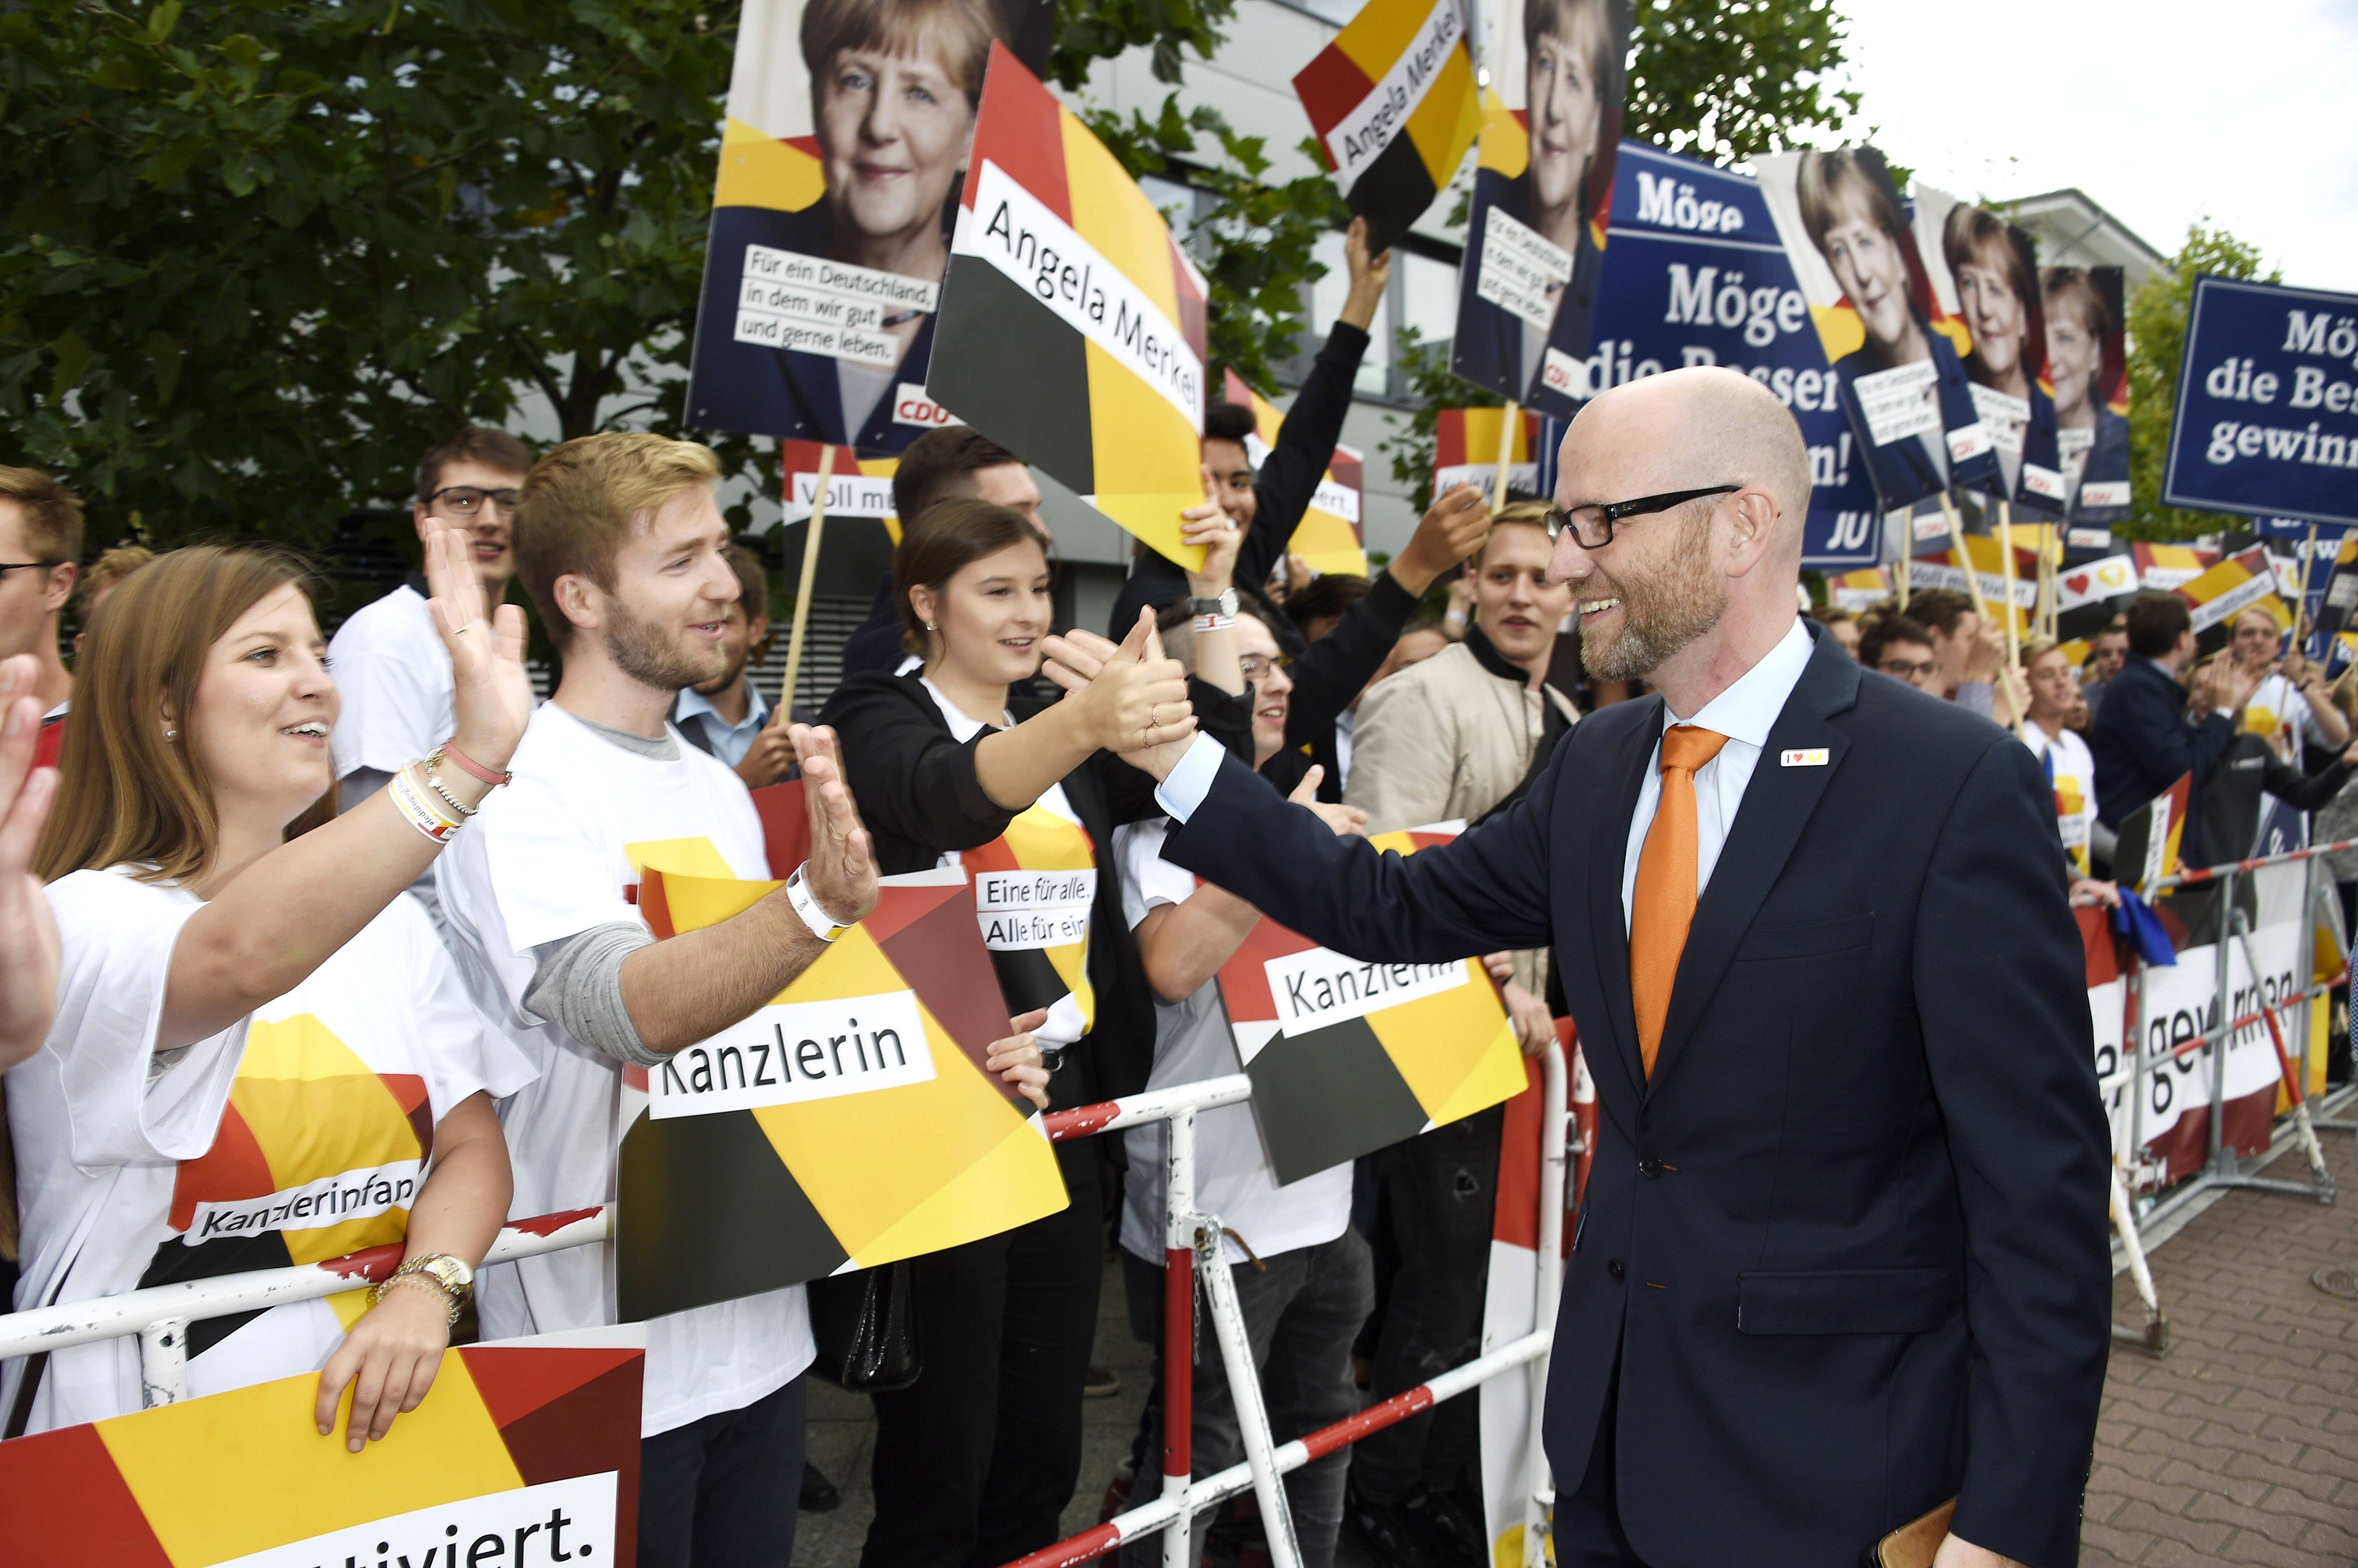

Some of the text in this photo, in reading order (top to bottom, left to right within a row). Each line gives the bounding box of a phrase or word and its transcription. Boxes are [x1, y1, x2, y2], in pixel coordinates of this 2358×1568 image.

[1345, 84, 1409, 166] Angela
[751, 251, 931, 307] Für ein Deutschland,
[747, 282, 877, 328] in dem wir gut
[984, 199, 1197, 413] Angela Merkel
[1664, 263, 1806, 348] Möge
[742, 319, 891, 359] und gerne leben.
[2282, 309, 2358, 370] Mö
[2206, 356, 2280, 405] die
[898, 400, 951, 425] CDU
[801, 482, 852, 508] Voll
[1826, 511, 1871, 550] JU
[987, 876, 1090, 904] Eine für alle.
[986, 918, 1028, 943] Alle
[1032, 916, 1054, 941] für
[662, 1018, 906, 1097] Kanzlerin
[200, 1173, 414, 1237] Kanzlerinfan
